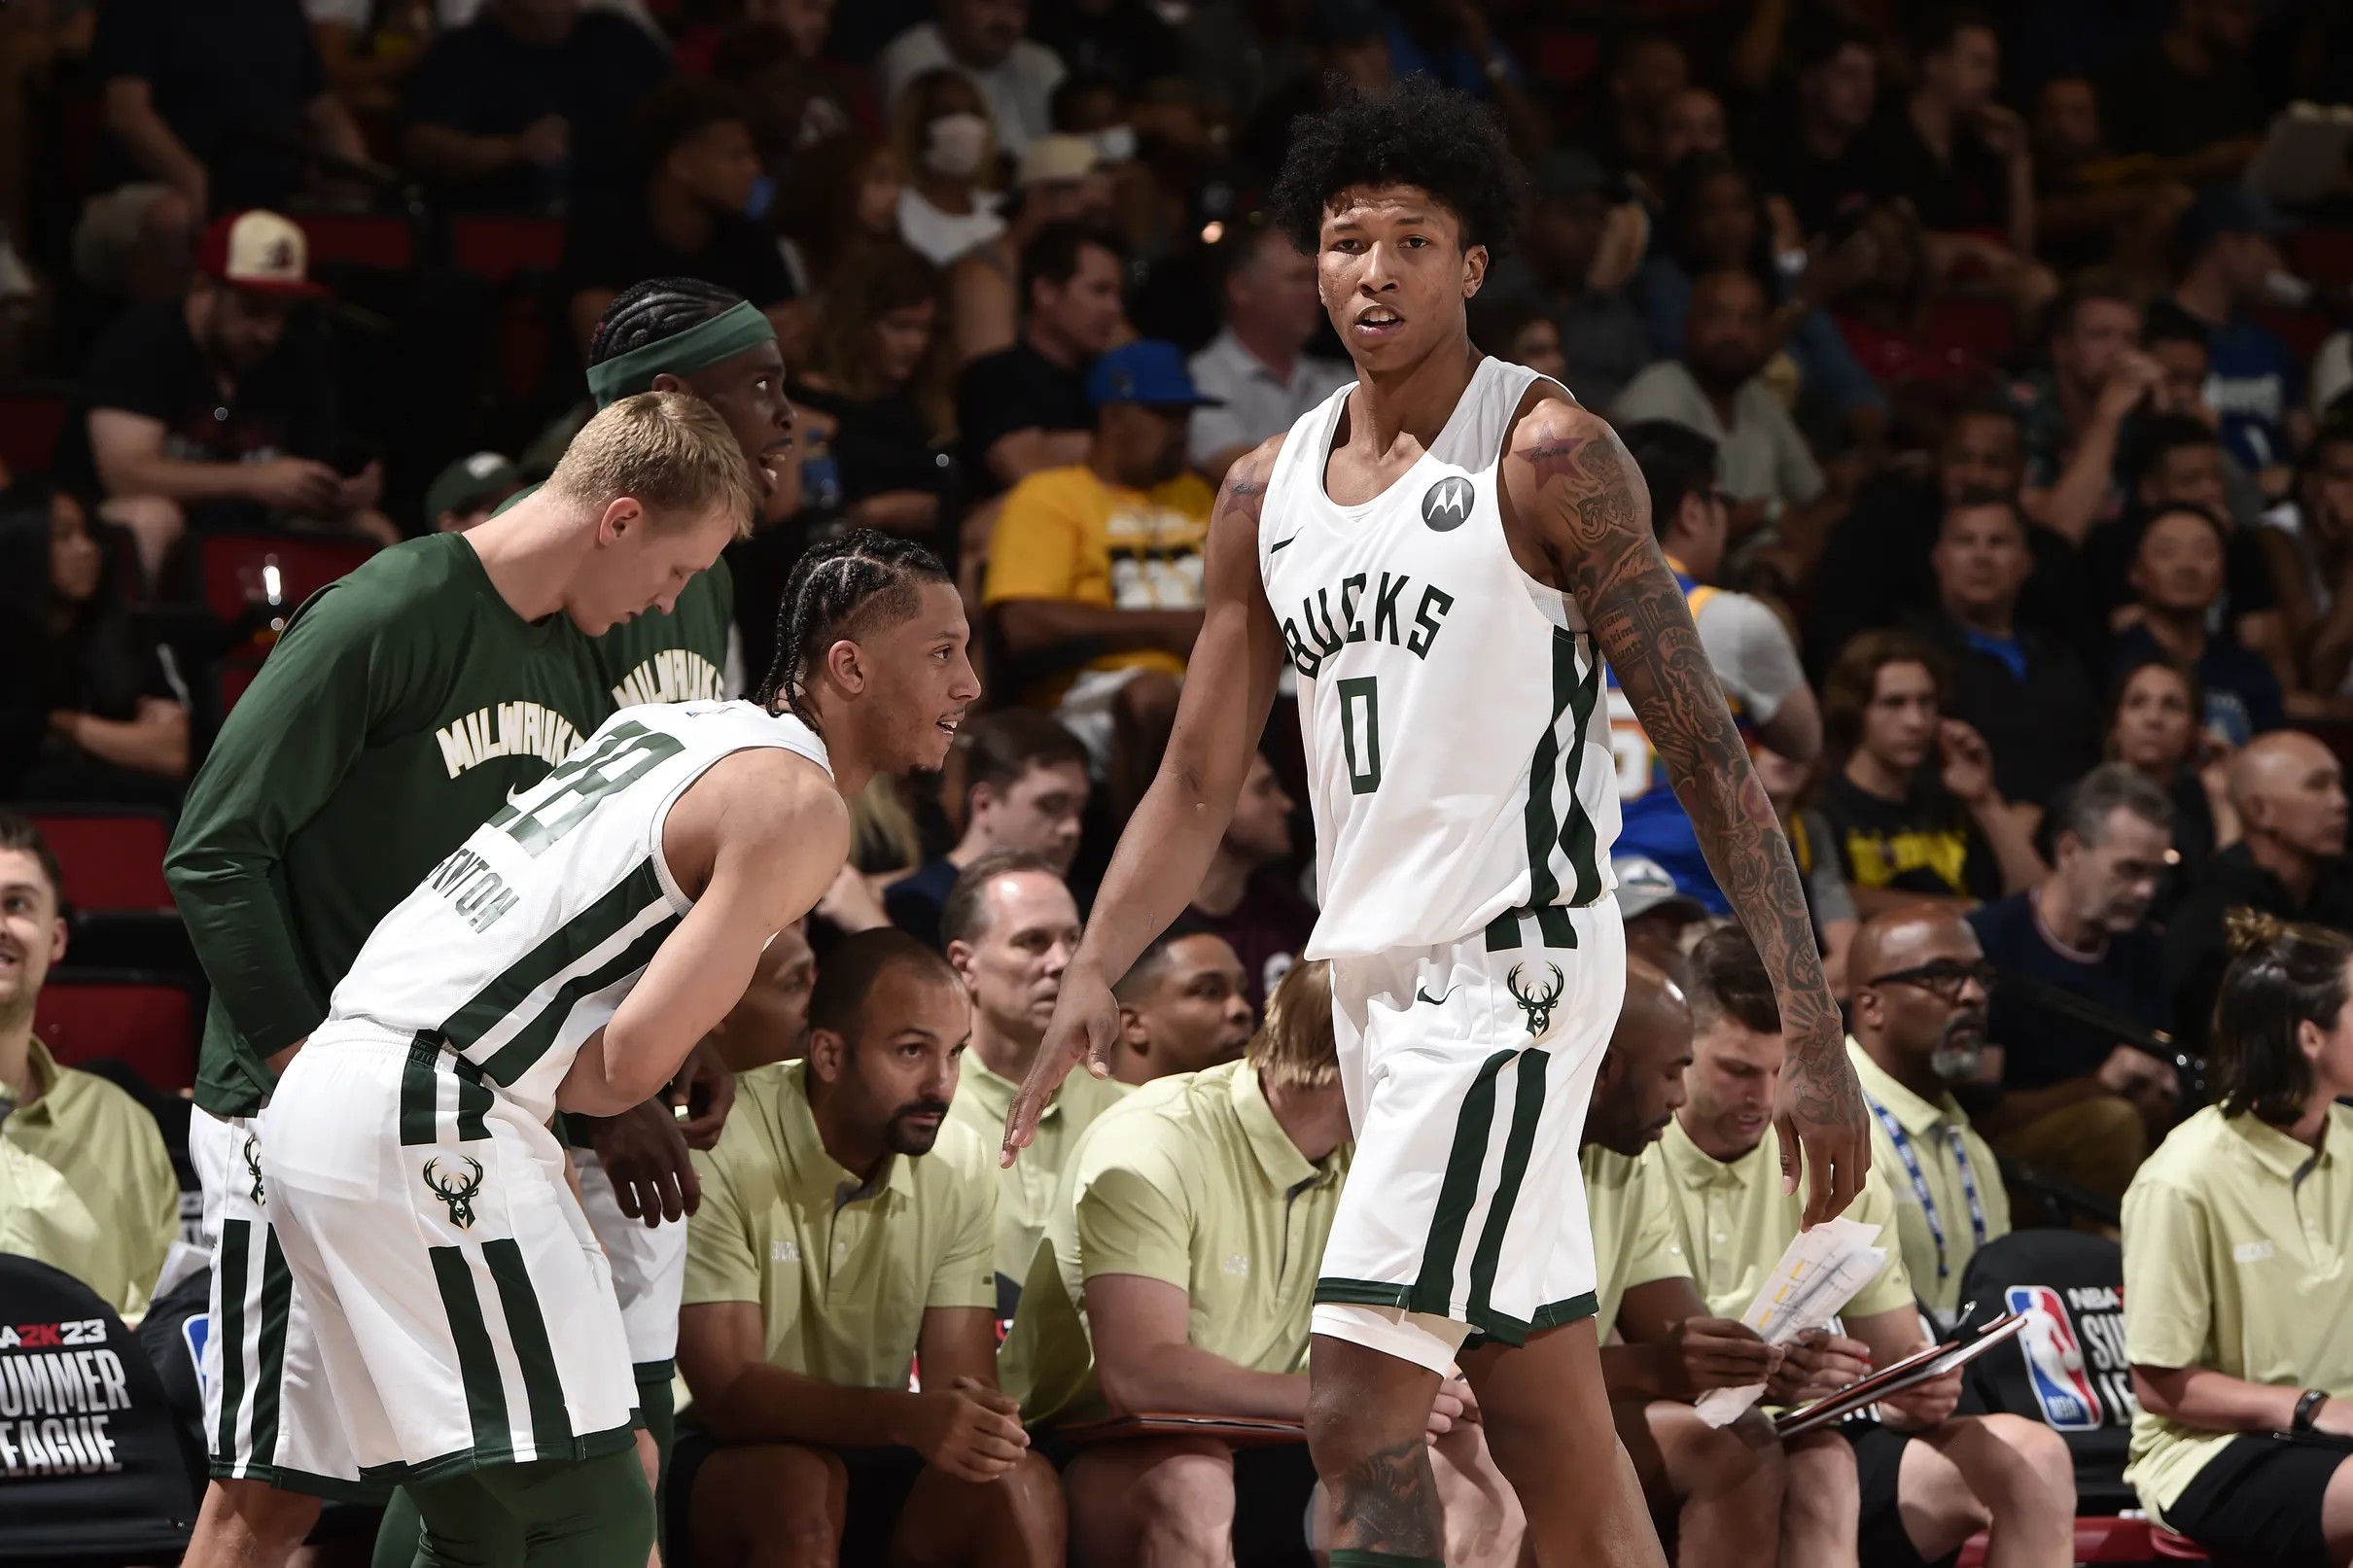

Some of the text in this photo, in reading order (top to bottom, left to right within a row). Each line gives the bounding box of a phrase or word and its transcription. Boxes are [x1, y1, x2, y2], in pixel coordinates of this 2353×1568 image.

[1283, 571, 1456, 680] BUCKS
[1336, 676, 1382, 795] 0
[0, 1318, 107, 1348] A2K23
[0, 1348, 133, 1417] UMMER
[0, 1413, 123, 1478] EAGUE
